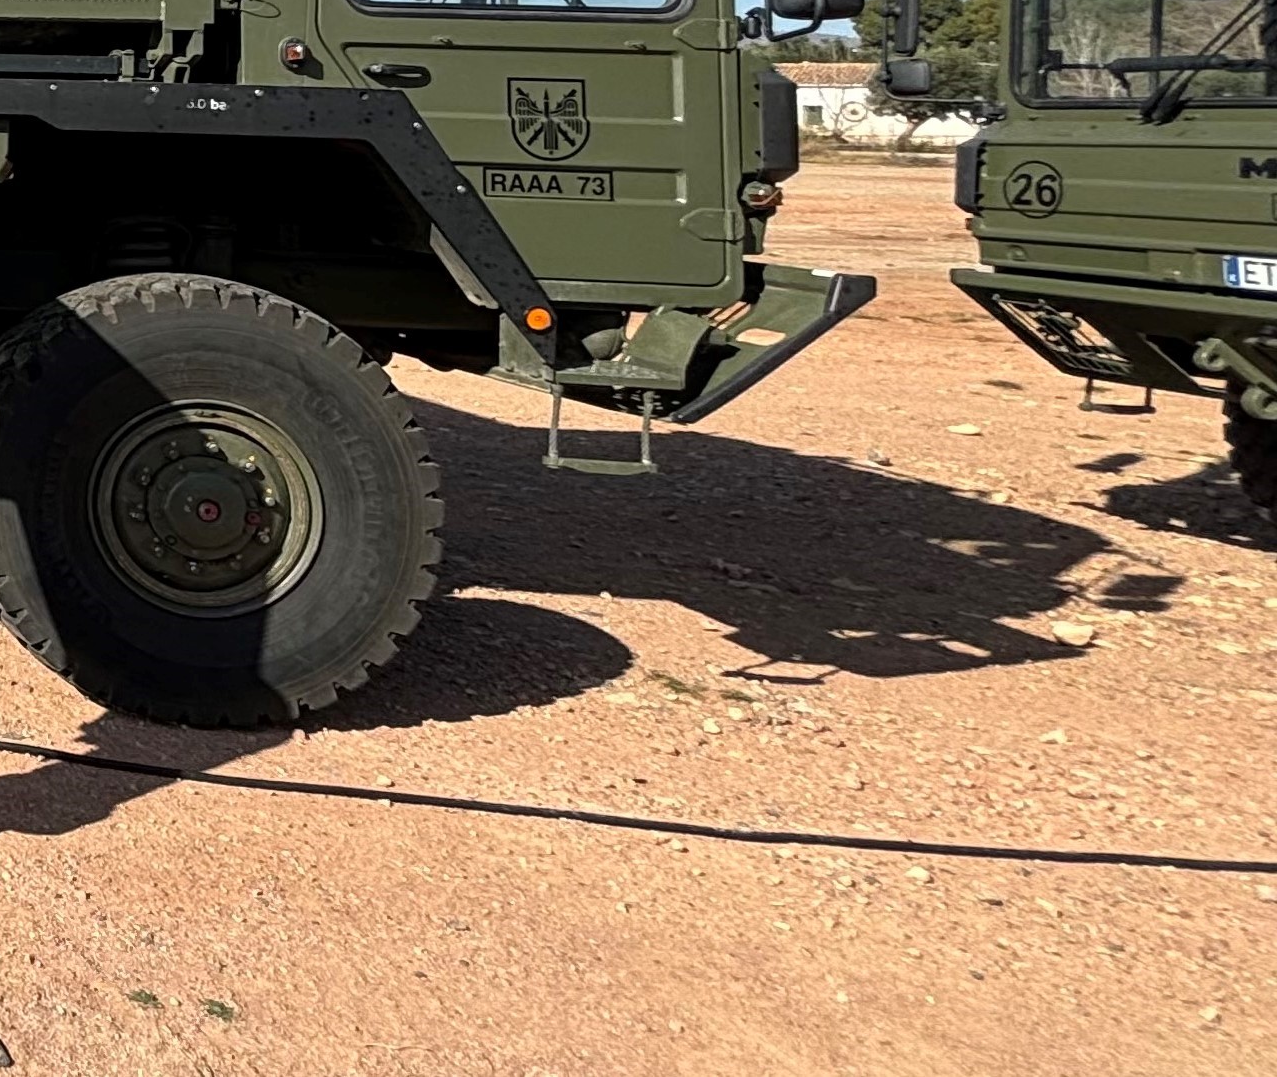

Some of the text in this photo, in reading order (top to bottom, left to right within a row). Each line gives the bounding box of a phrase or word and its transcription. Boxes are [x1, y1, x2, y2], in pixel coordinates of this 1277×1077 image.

[491, 173, 606, 196] RAAA 73
[1012, 173, 1057, 207] 26
[1244, 261, 1277, 286] ET
